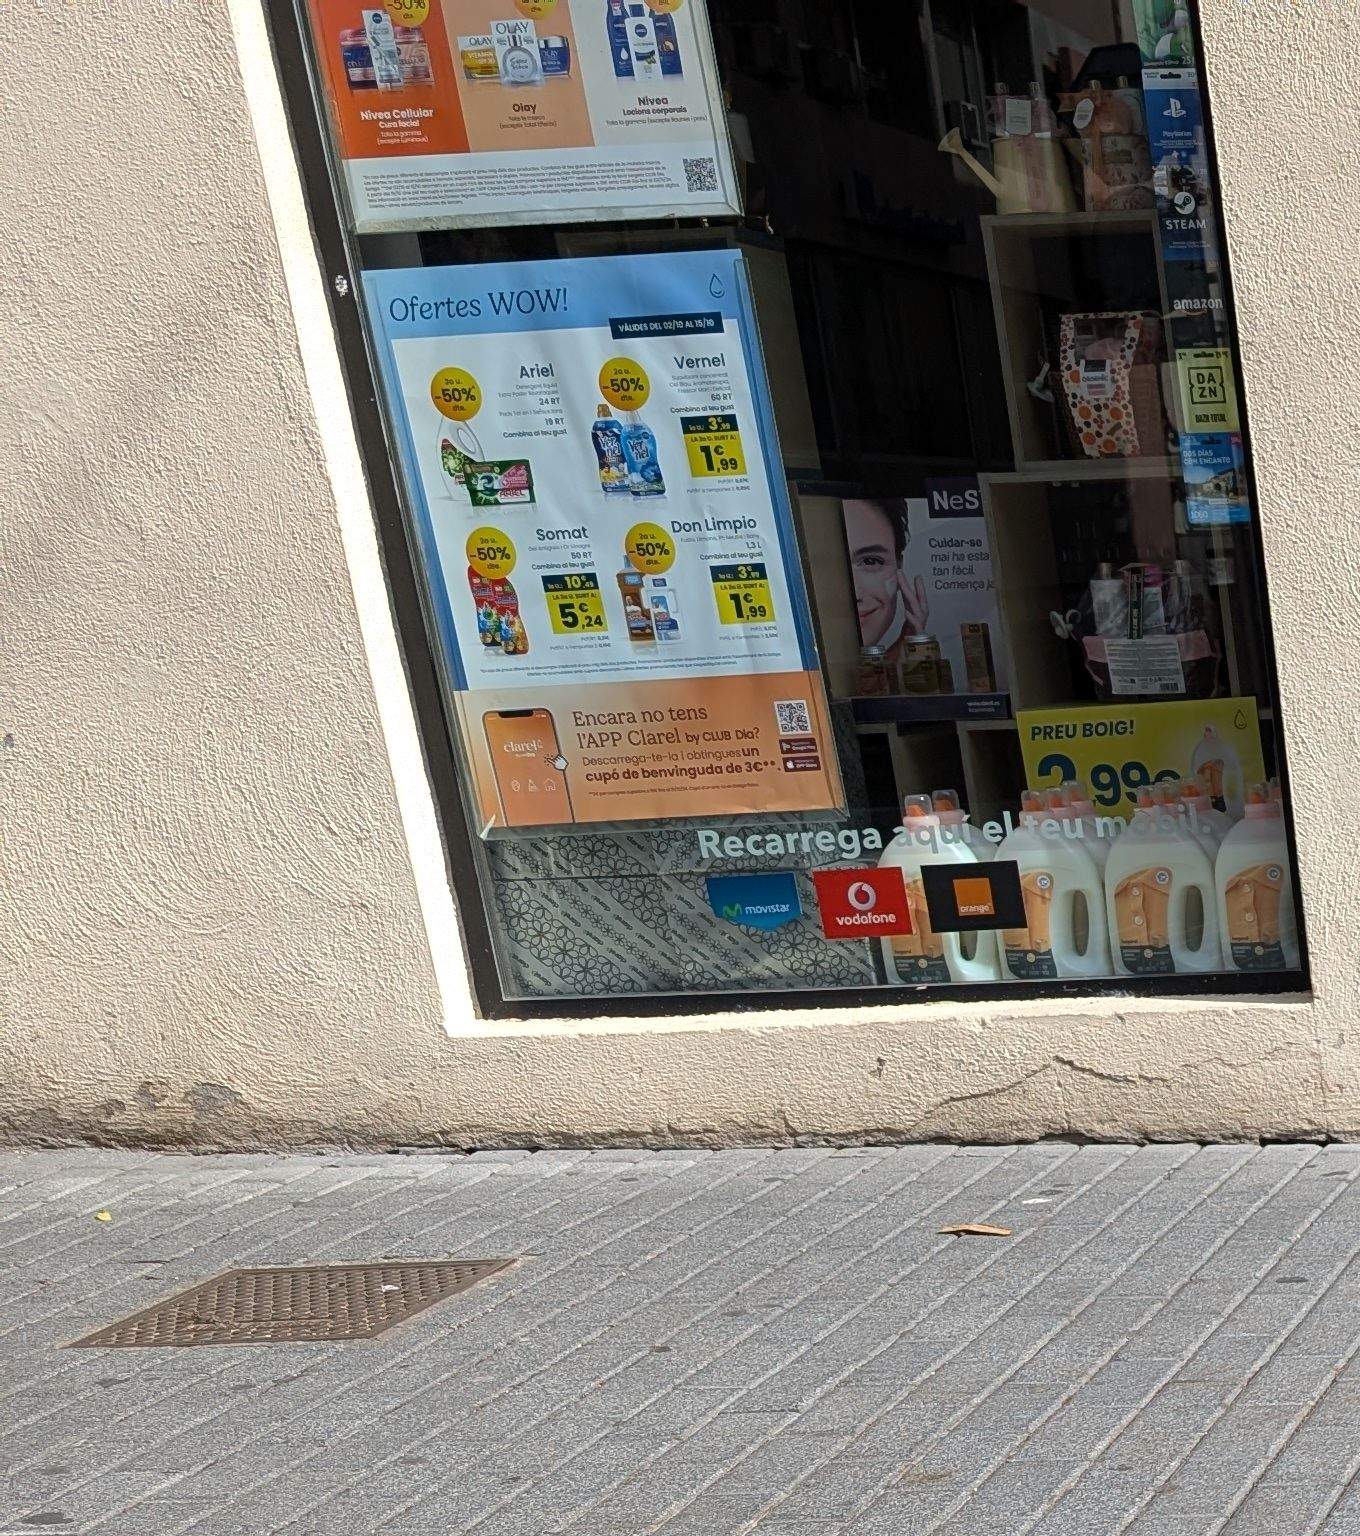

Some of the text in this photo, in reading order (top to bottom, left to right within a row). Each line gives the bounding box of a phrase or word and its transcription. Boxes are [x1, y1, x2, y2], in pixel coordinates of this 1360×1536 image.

[496, 22, 528, 34] OLAY
[637, 96, 668, 105] Nivea
[361, 108, 434, 119] Nivea Cellular
[512, 103, 537, 113] Olay
[623, 106, 687, 116] Locions corporals
[1166, 219, 1206, 230] STEAM
[390, 288, 568, 322] Ofertes WOW!
[1173, 298, 1223, 309] amazon
[650, 322, 662, 330] DEL
[685, 320, 694, 328] AL
[674, 353, 725, 369] Vernel
[520, 363, 554, 378] Ariel
[603, 378, 644, 392] -50%
[671, 516, 756, 534] Don Limpio
[536, 526, 588, 541] Somat
[629, 542, 670, 557] -50%
[929, 538, 982, 548] Cuidar-se
[470, 547, 511, 561] -50%
[931, 554, 949, 562] mai
[952, 551, 965, 561] ha
[933, 567, 949, 575] tan
[935, 580, 984, 591] Comença
[573, 707, 708, 727] Encara no tens
[1031, 720, 1134, 741] PREU BOIG!
[576, 727, 760, 749] l'APP Clarel by CLUB Dia?
[504, 740, 537, 752] clarel
[582, 750, 678, 767] Descarrega-te-la
[686, 749, 741, 763] obtingues
[742, 746, 760, 757] un
[585, 768, 621, 783] cupó
[624, 766, 640, 779] de
[642, 762, 723, 779] benvinguda
[725, 761, 742, 774] de
[697, 827, 883, 859] Recarrega
[892, 814, 970, 853] aquí
[982, 811, 1014, 843] el
[1025, 814, 1085, 841] teu
[745, 902, 791, 915] movistar
[960, 904, 990, 913] orange
[836, 912, 897, 927] vodafone
